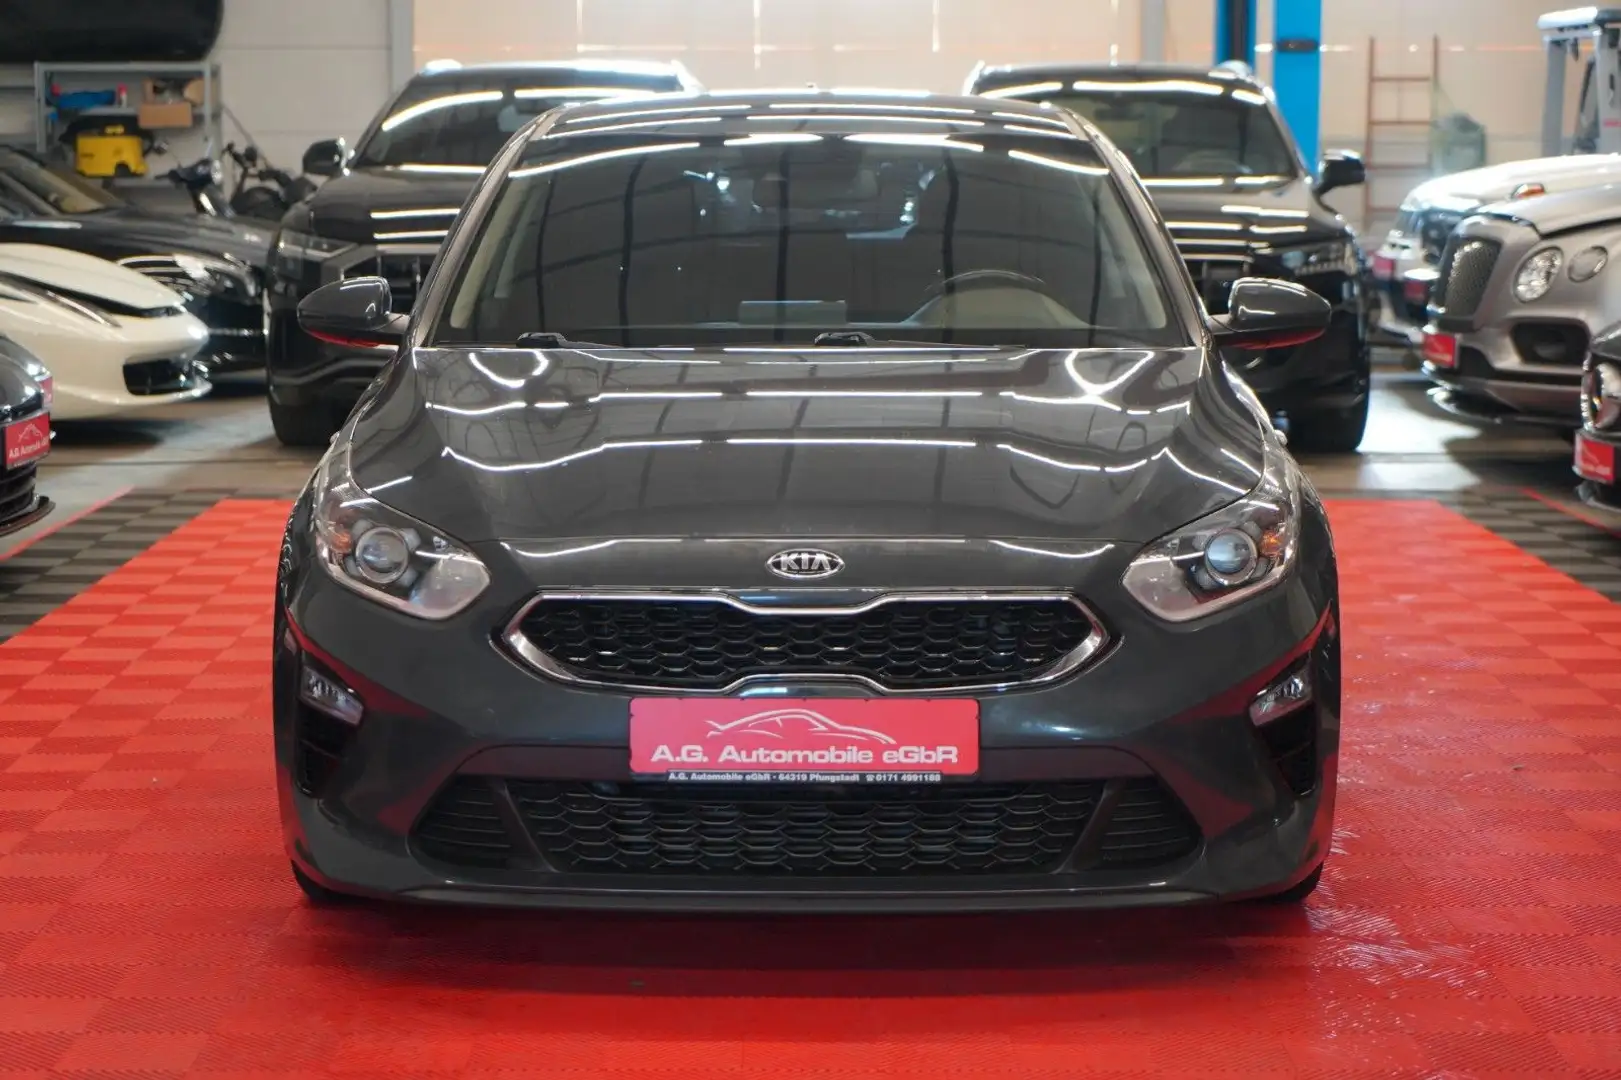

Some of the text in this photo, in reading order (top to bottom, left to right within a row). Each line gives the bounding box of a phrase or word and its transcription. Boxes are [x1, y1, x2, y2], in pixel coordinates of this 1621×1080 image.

[780, 552, 831, 571] KIA
[651, 744, 958, 763] A.G. Automobile eGbR
[668, 772, 688, 780] A.G.
[691, 772, 743, 780] Automobile
